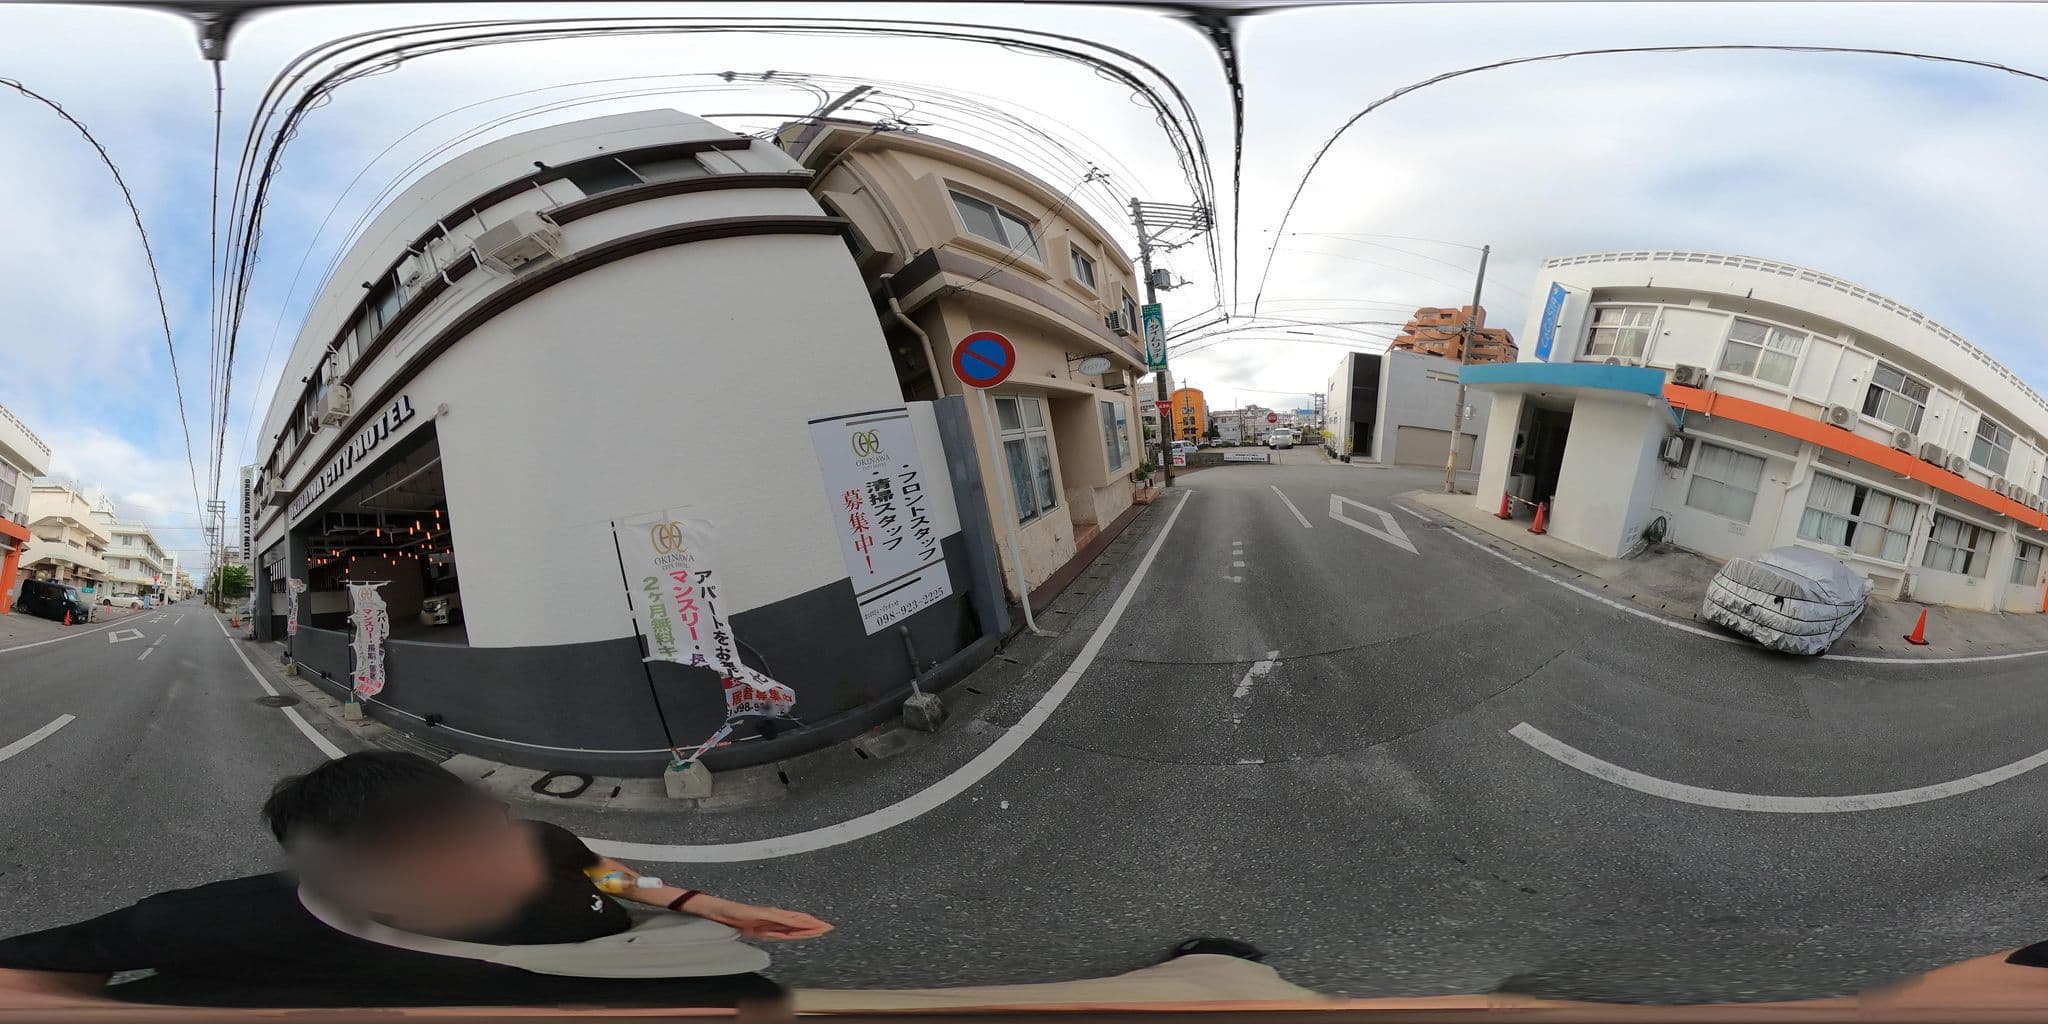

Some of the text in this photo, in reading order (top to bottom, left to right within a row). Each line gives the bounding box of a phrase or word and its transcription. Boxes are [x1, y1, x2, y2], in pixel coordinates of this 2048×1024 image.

[288, 394, 416, 521] OKINAWA CITY HOTEL
[855, 454, 890, 468] OKINAWA
[243, 478, 251, 560] OKINAWA CITY HOTEL
[654, 552, 695, 566] OKINAWA
[642, 576, 679, 661] 2ヶ月無料キ
[876, 586, 944, 627] 098-923-2225
